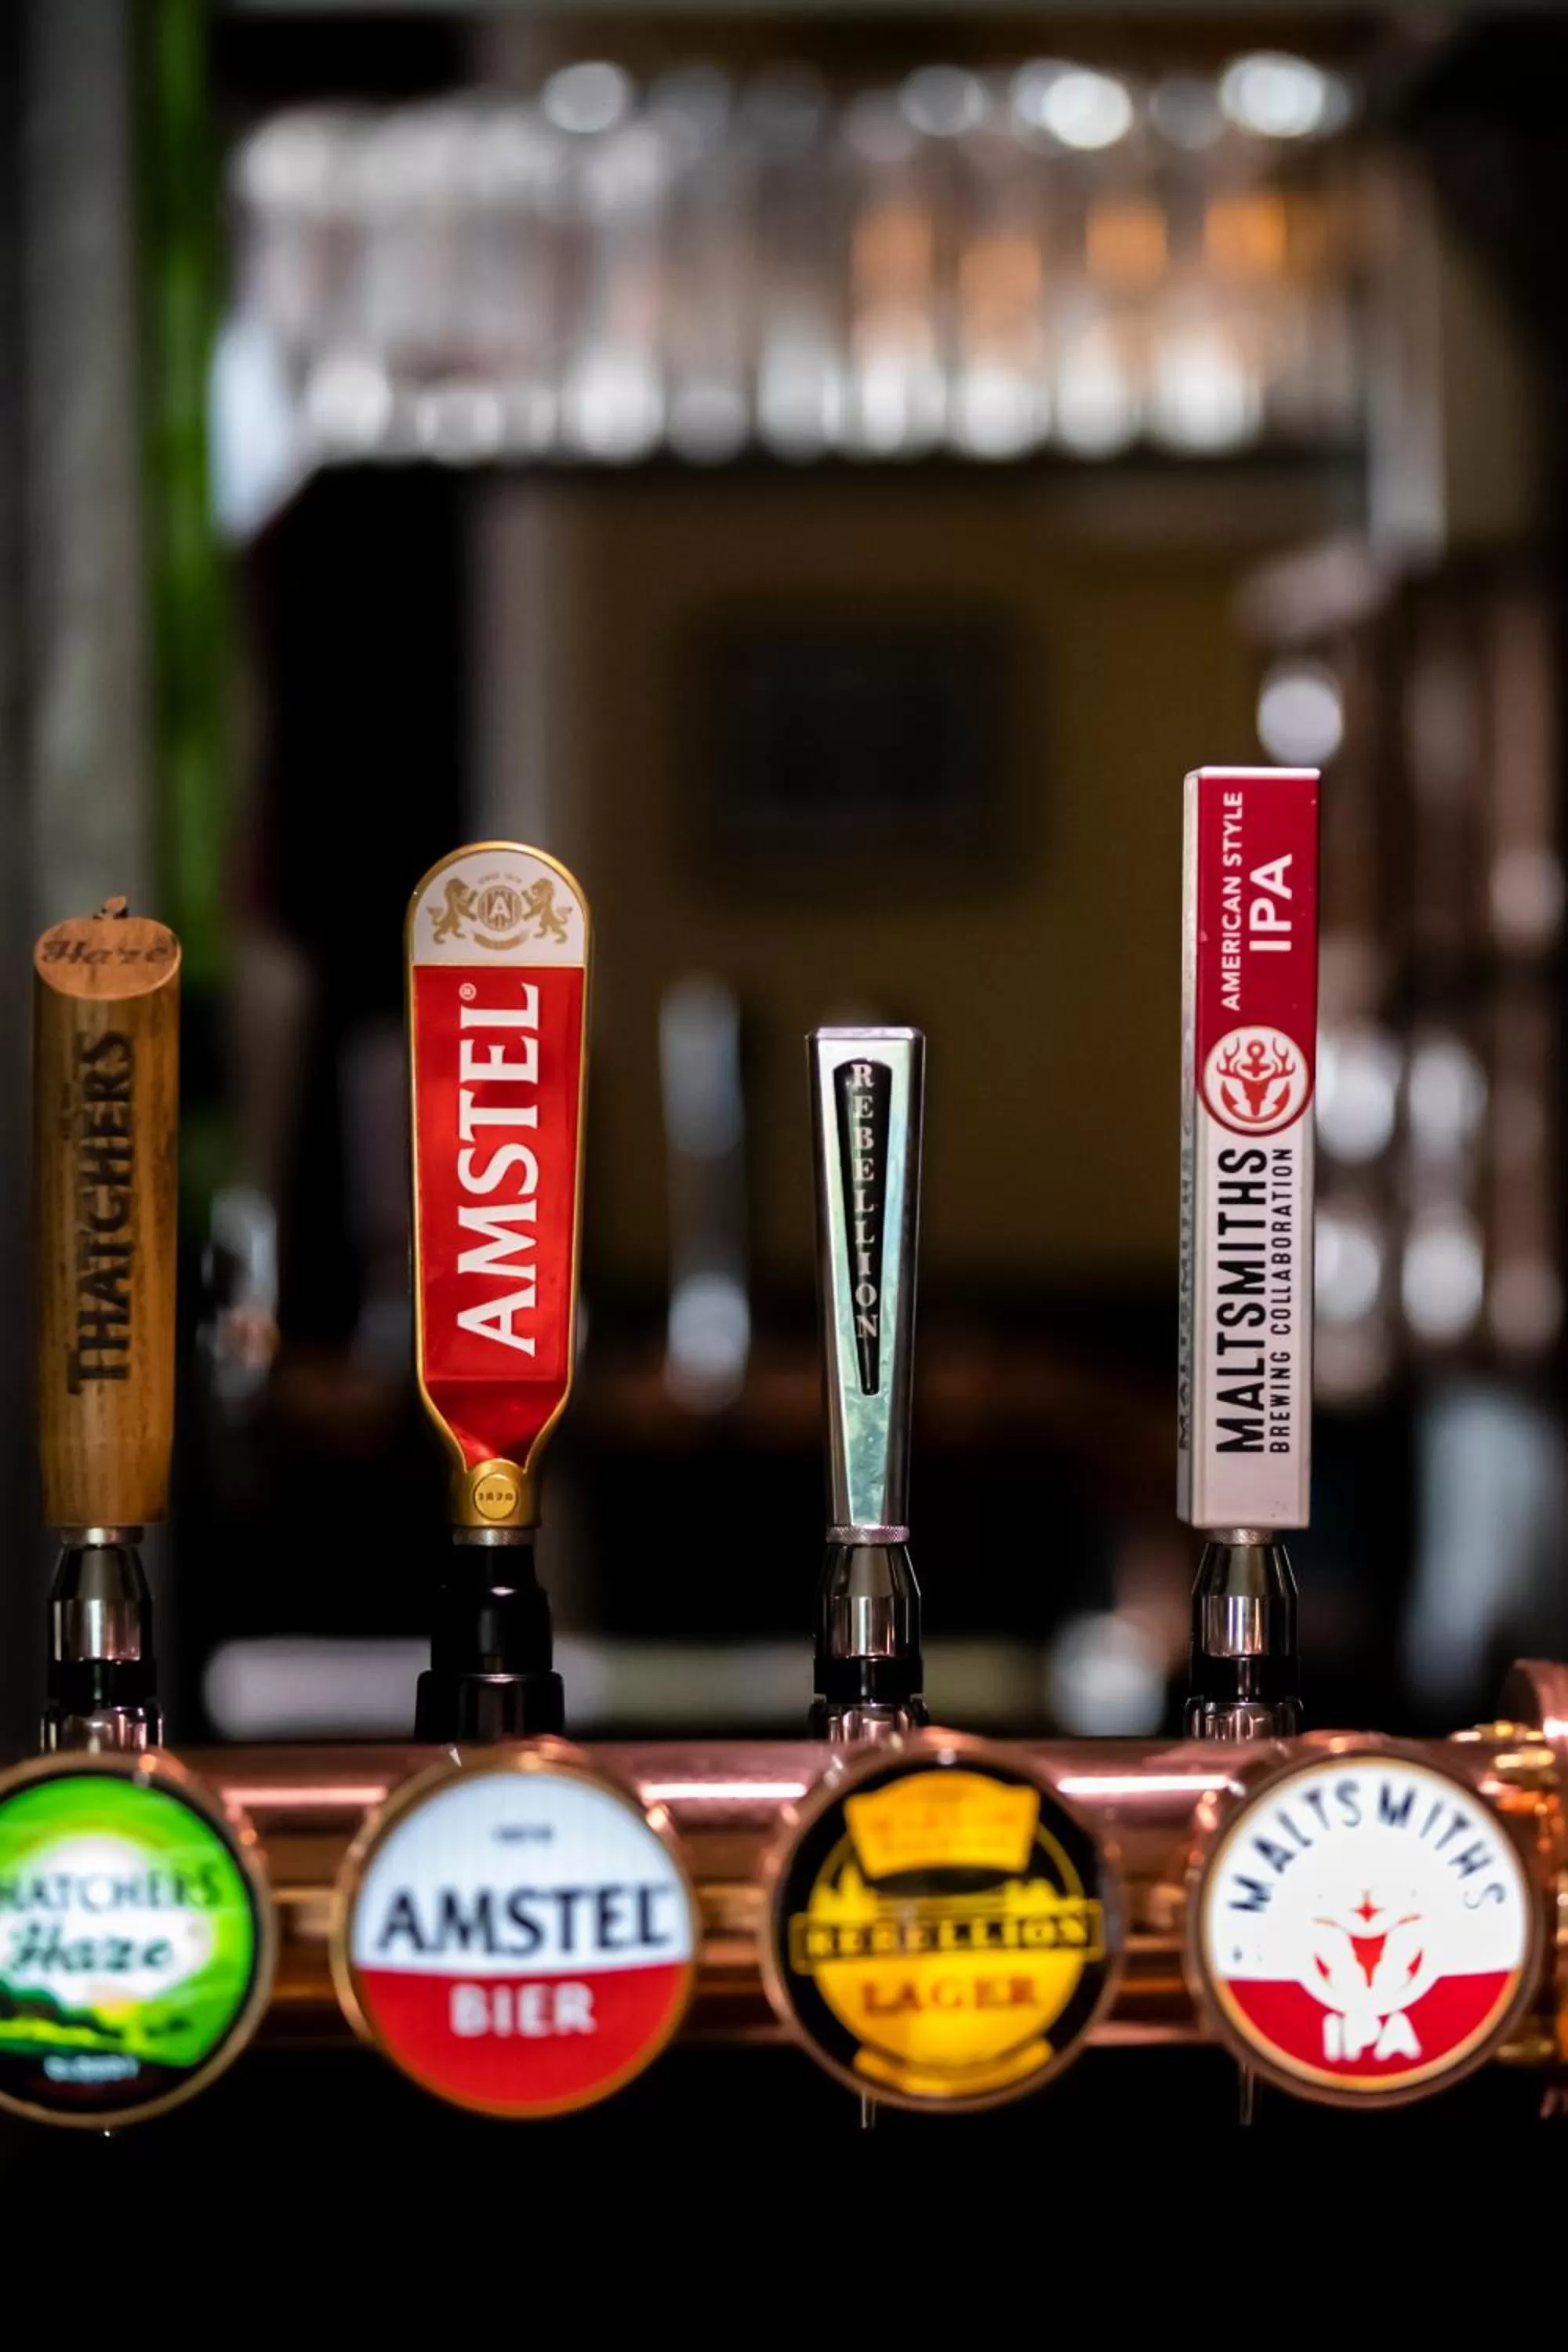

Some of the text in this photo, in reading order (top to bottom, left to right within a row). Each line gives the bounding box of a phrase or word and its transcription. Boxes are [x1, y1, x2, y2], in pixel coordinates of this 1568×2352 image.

[488, 895, 511, 920] A
[1221, 792, 1243, 1011] AMERICAN STYLE
[1249, 853, 1293, 952] IPA
[67, 1029, 135, 1396] THATCHERS
[851, 1063, 878, 1338] REBELLION
[1216, 1148, 1268, 1454] MALTSMITHS
[1269, 1148, 1293, 1454] BREWING COLLABORATION
[1228, 1779, 1507, 1913] MALTSMITHS
[376, 1883, 671, 1955] AMSTEL
[450, 1982, 597, 2038] BIER
[862, 1974, 1037, 2016] LAGER
[1323, 2010, 1422, 2062] IPA
